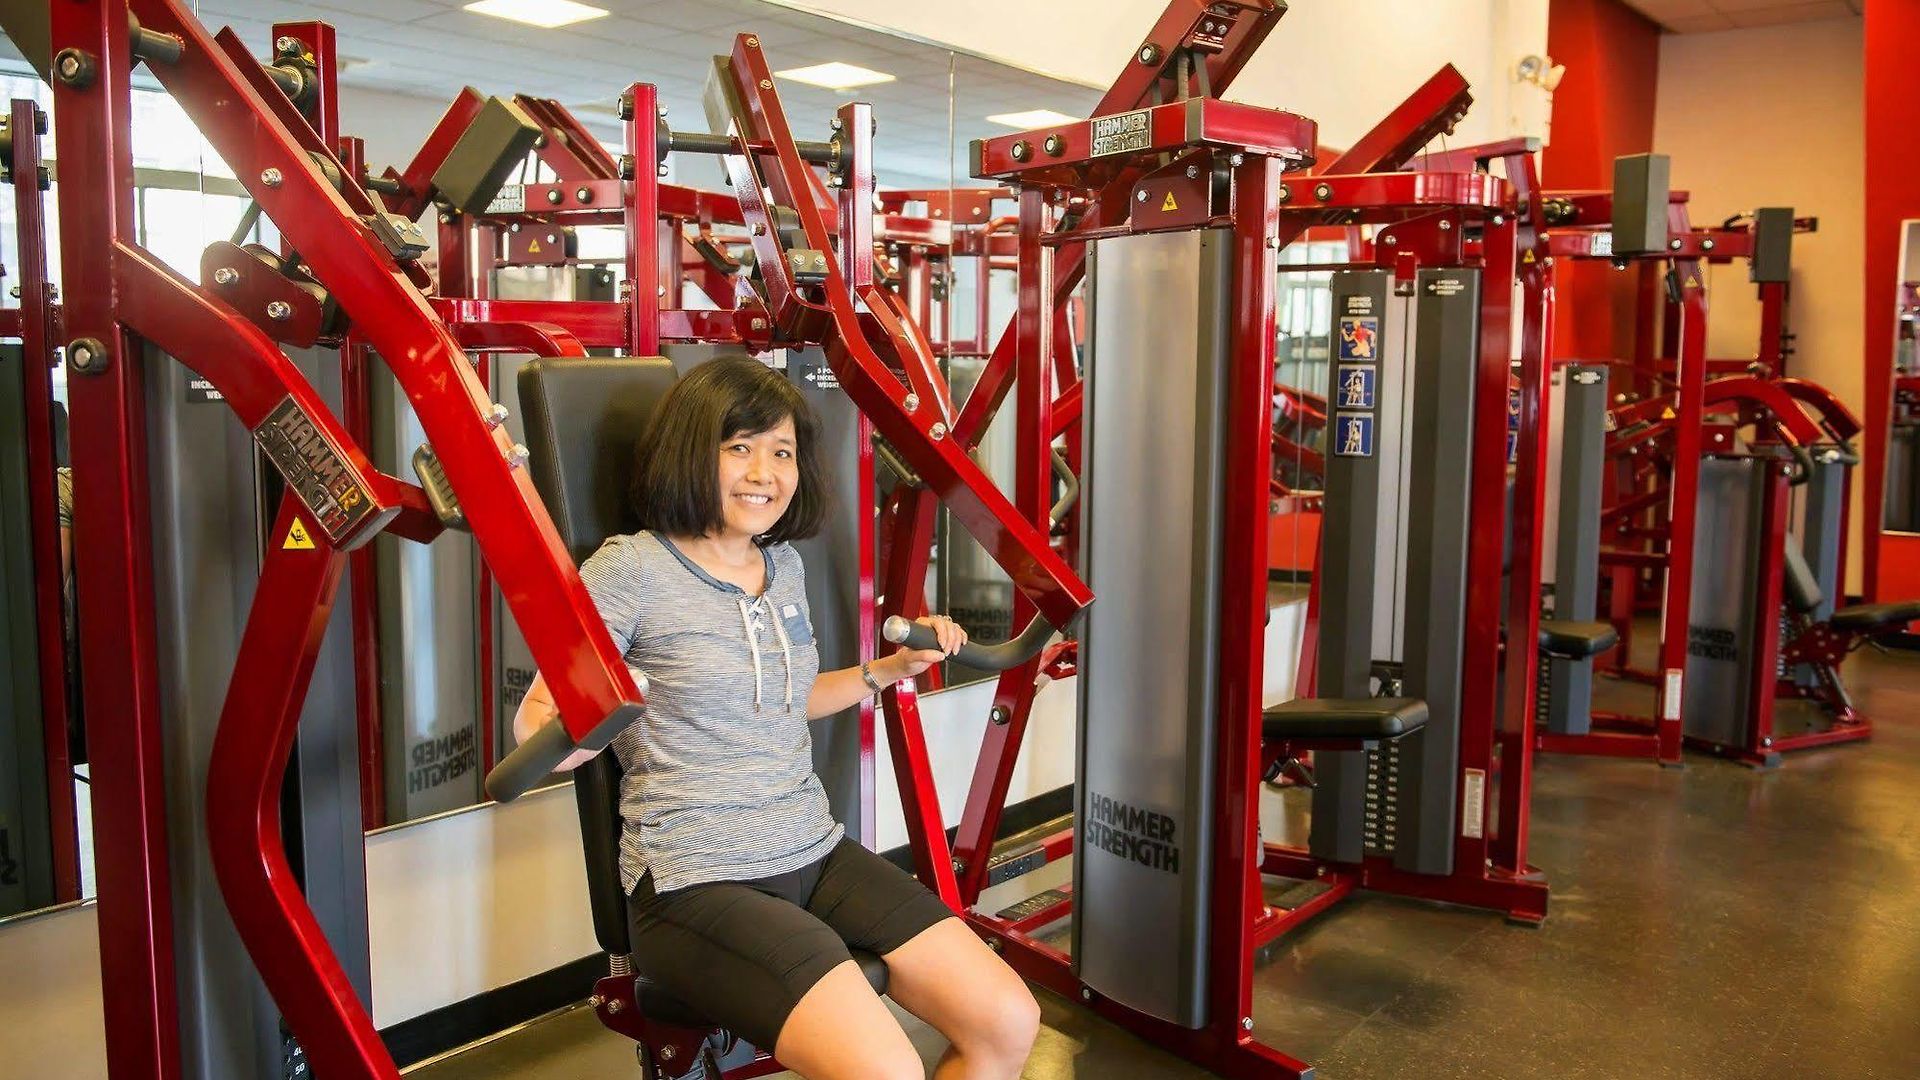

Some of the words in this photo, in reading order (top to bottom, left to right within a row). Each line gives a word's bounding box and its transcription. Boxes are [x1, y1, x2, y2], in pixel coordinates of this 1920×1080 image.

[1093, 130, 1148, 154] STRENGTH
[1096, 114, 1146, 138] HAMMER
[259, 421, 348, 533] STRENGTH
[277, 406, 361, 512] HAMMER
[1091, 792, 1175, 844] HAMMER
[1087, 820, 1179, 875] STRENGTH
[296, 1063, 305, 1075] 50
